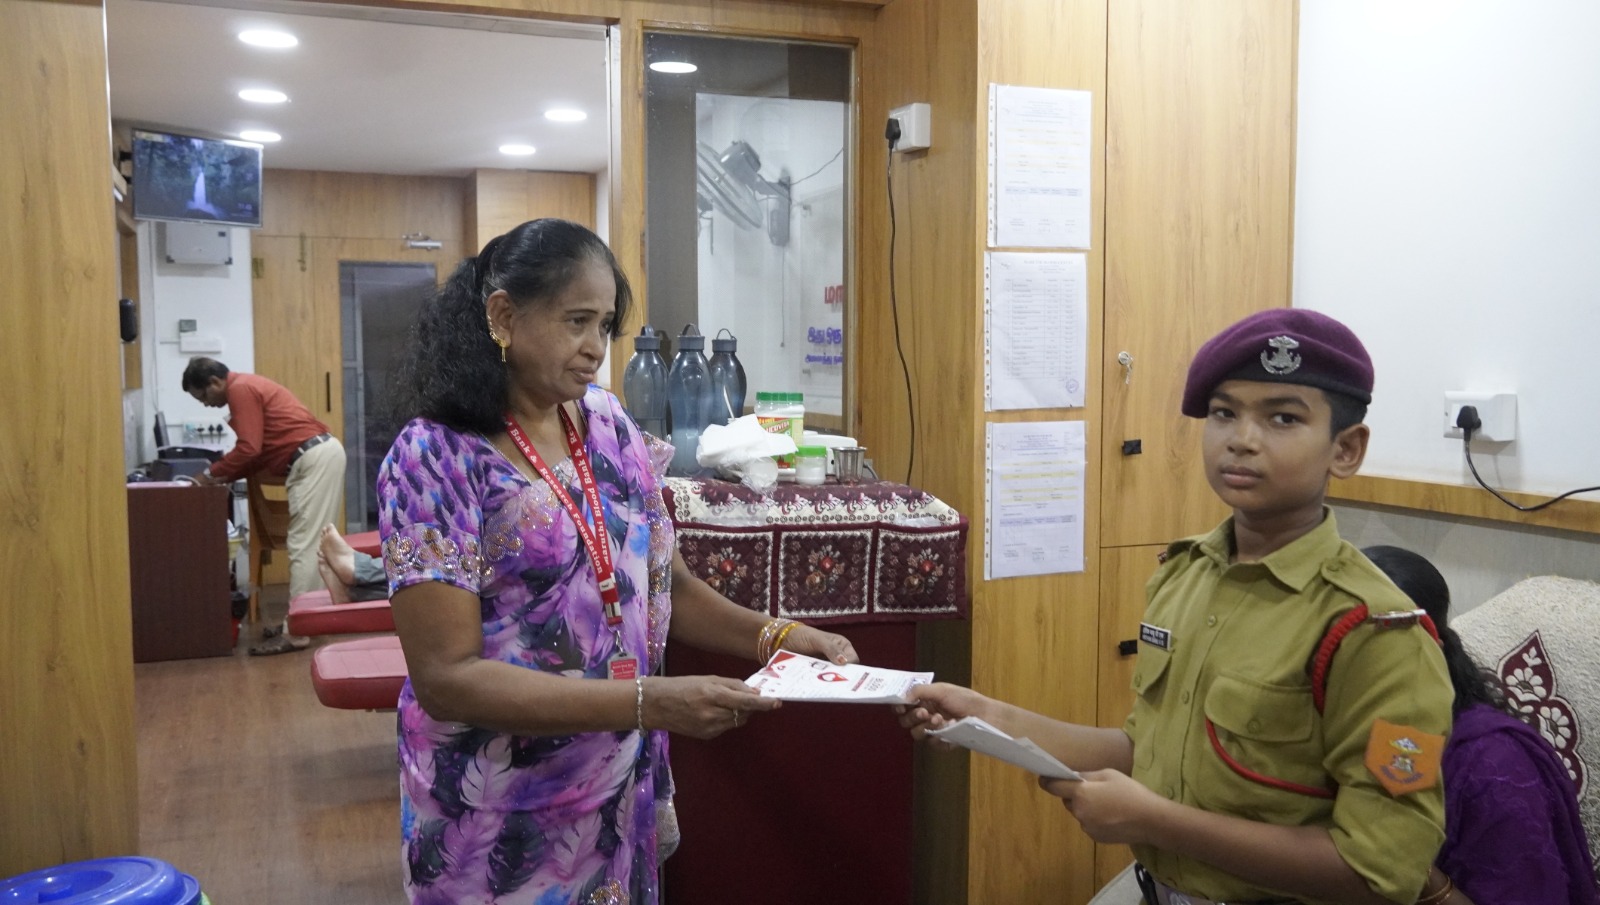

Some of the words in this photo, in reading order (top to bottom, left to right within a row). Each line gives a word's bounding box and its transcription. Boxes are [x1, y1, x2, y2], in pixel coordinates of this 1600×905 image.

[574, 448, 583, 457] &
[578, 459, 592, 484] Bank
[510, 428, 531, 454] Bank
[530, 455, 538, 463] &
[539, 467, 573, 510] Research
[573, 512, 603, 574] Foundation
[588, 487, 602, 517] Blood
